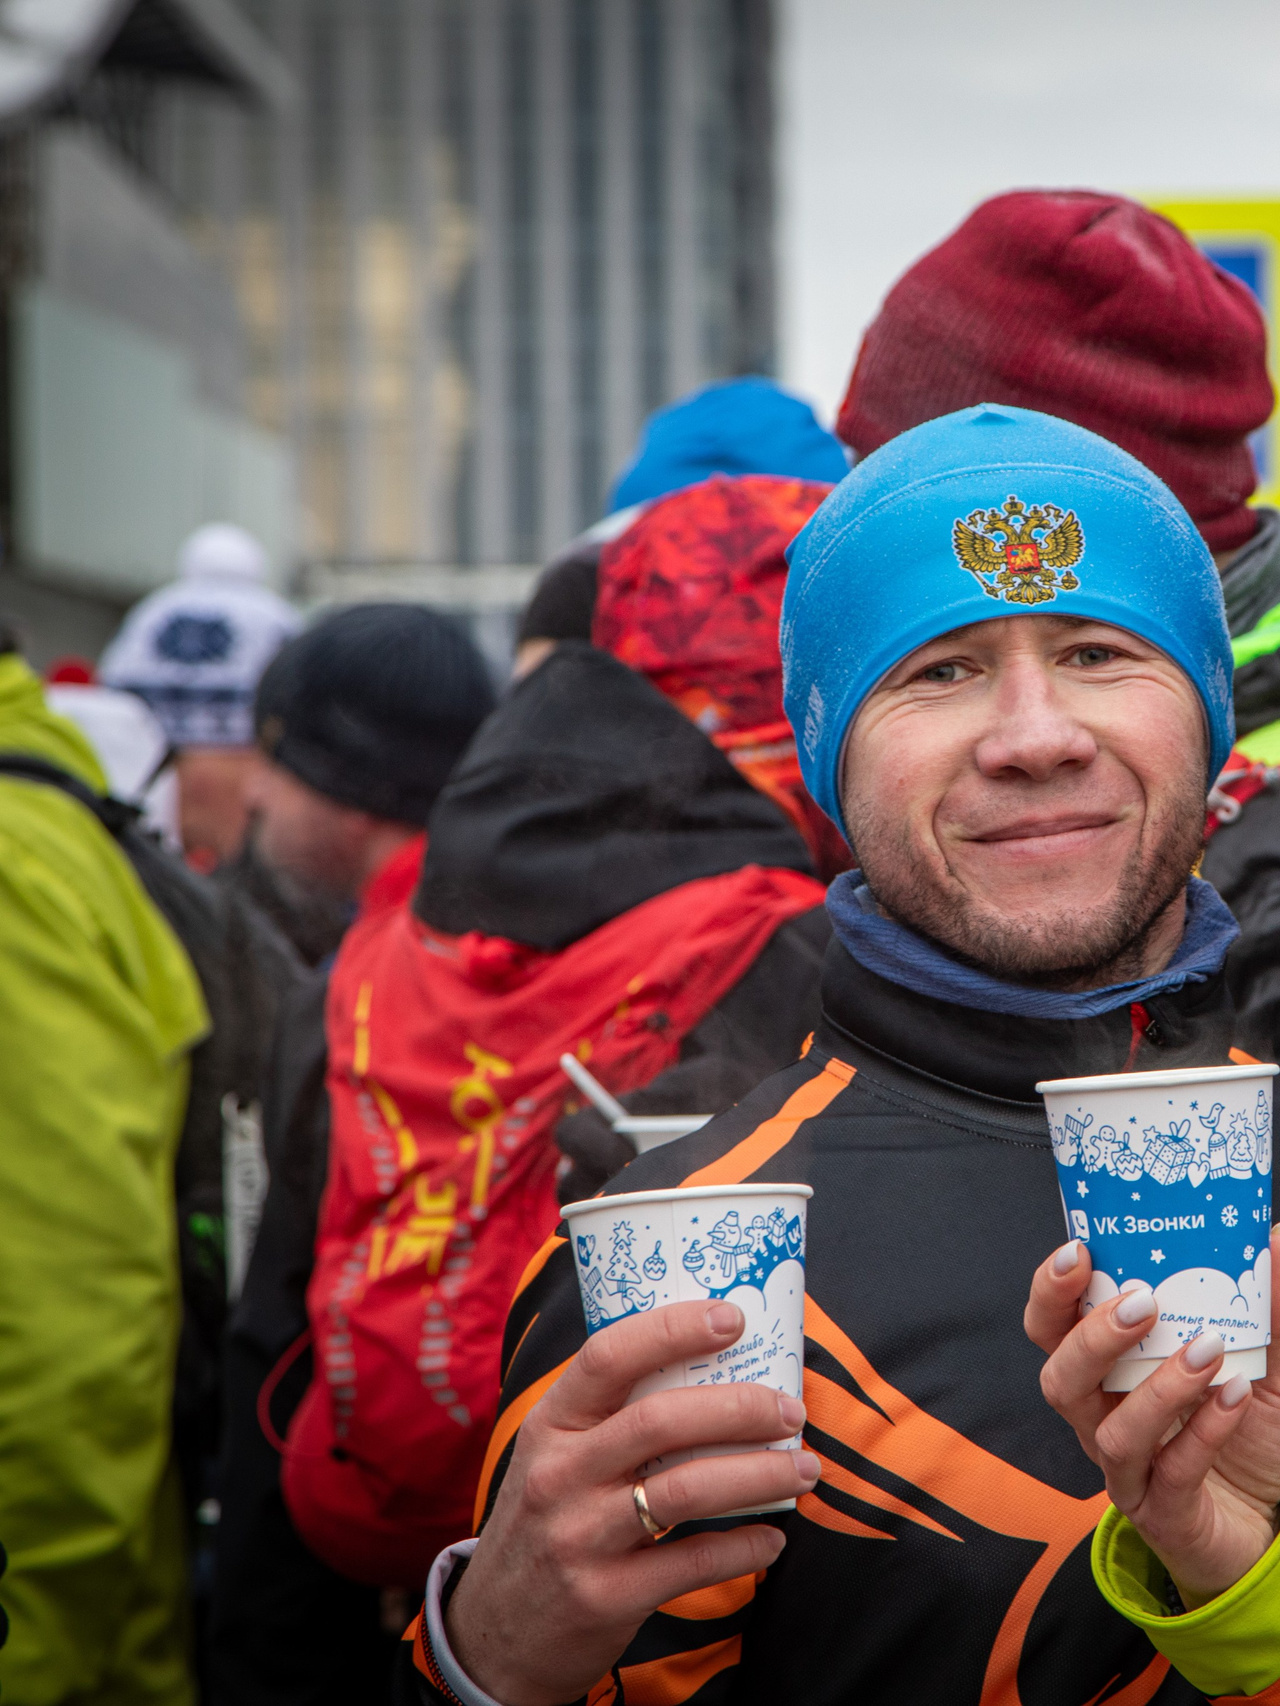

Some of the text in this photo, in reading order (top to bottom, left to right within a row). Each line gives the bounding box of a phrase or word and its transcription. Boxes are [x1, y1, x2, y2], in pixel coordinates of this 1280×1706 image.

[1093, 1214, 1205, 1235] VK Звонки
[1160, 1312, 1204, 1325] самые
[717, 1333, 764, 1364] спасибо
[710, 1342, 778, 1385] за этот год
